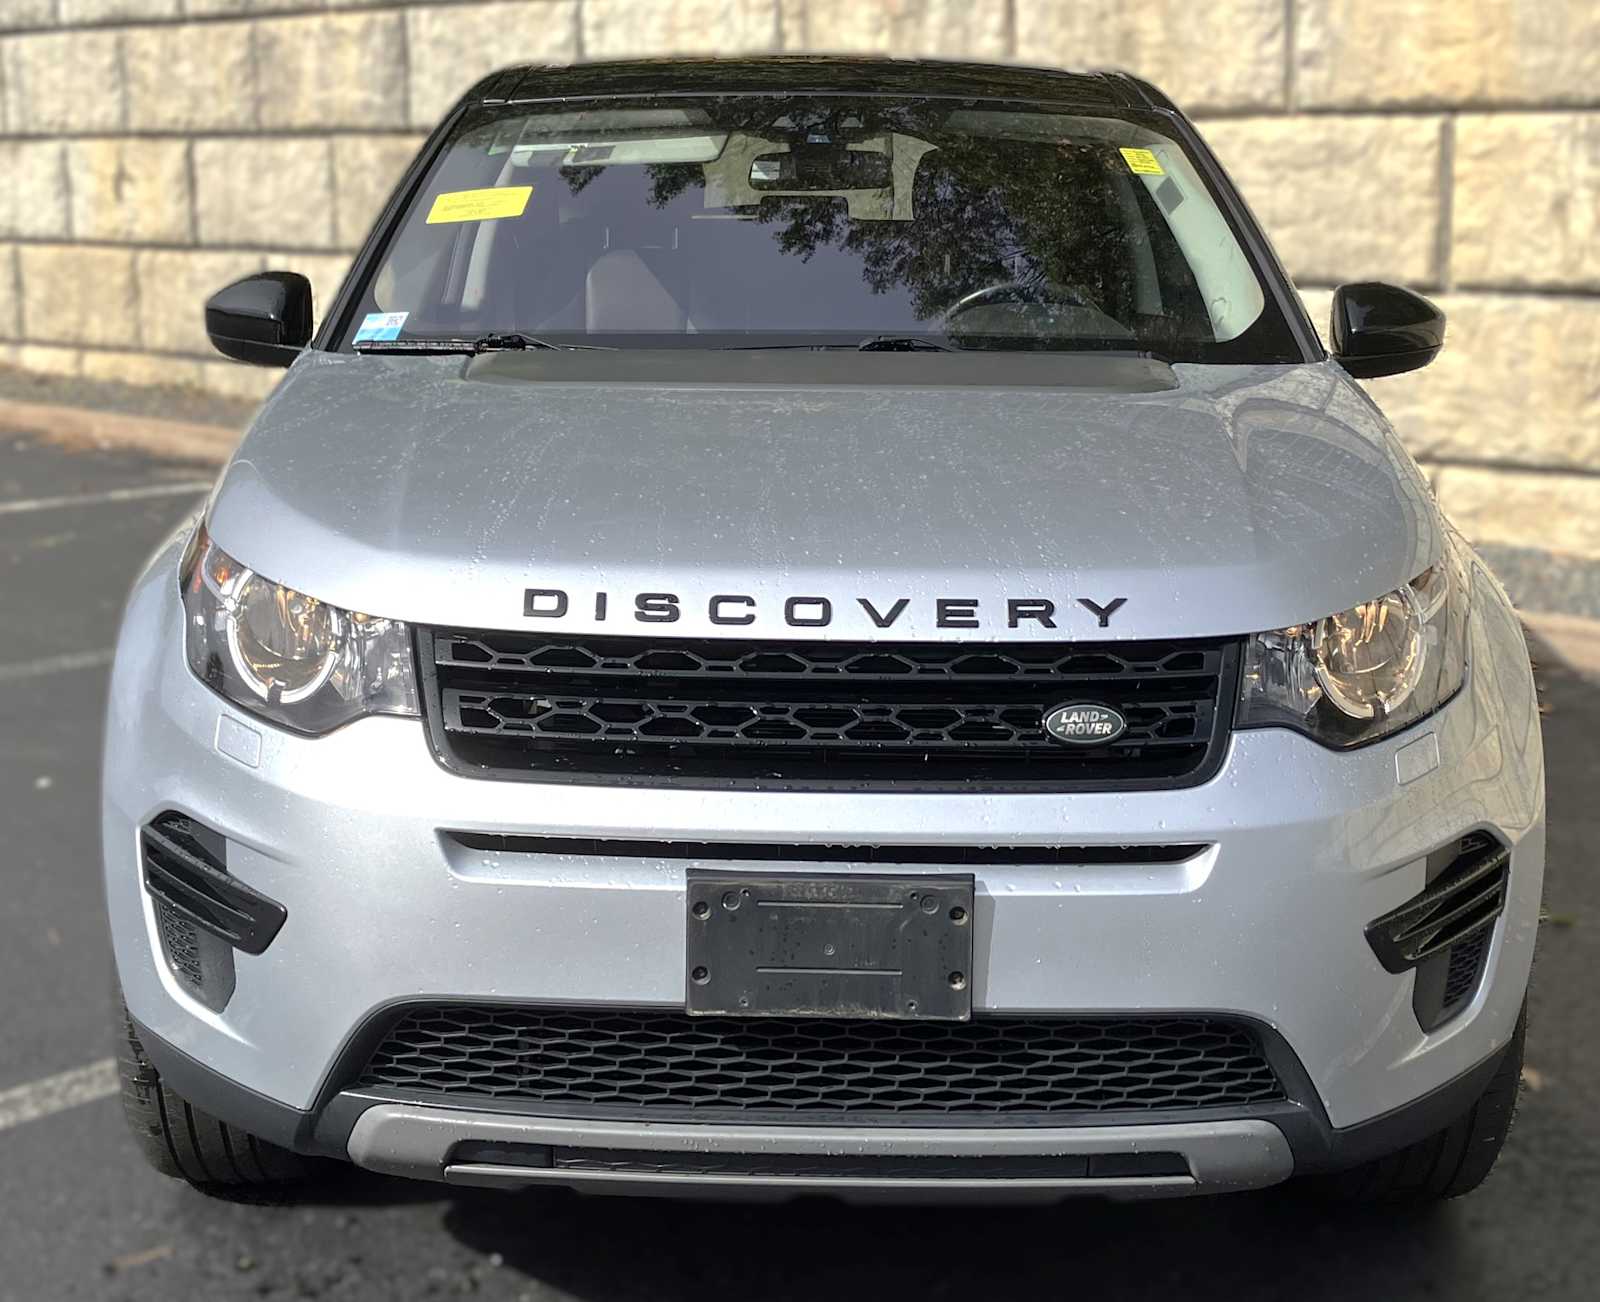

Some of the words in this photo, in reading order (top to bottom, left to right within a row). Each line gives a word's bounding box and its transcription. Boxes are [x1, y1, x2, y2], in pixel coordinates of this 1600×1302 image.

[523, 588, 1128, 629] DISCOVERY
[1061, 711, 1100, 723] LAND
[1065, 722, 1113, 735] ROVER
